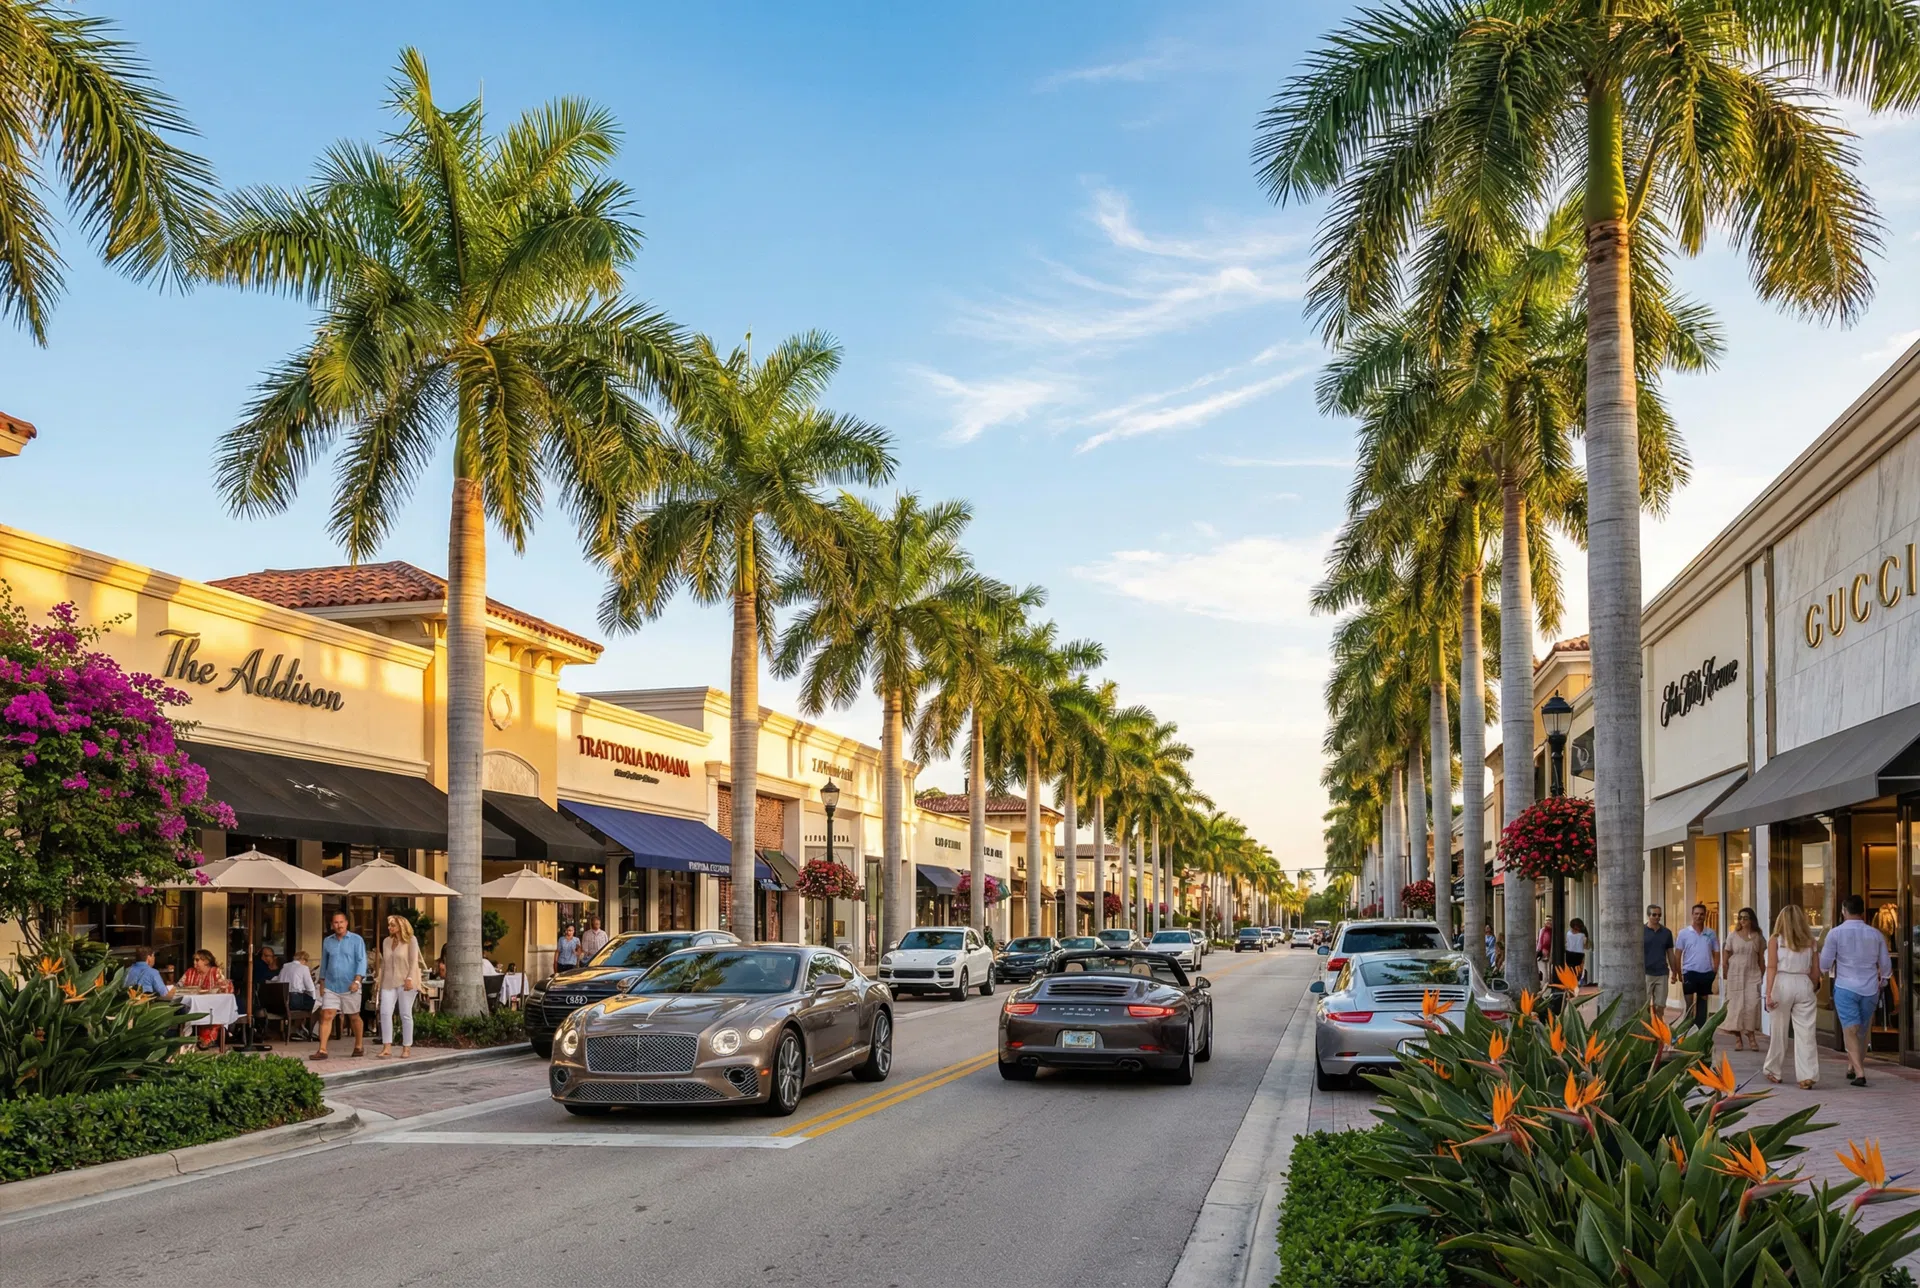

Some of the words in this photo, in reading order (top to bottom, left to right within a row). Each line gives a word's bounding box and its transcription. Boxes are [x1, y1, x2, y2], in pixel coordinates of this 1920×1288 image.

[1805, 543, 1917, 649] GUCCI
[157, 629, 218, 685] The
[216, 648, 344, 712] Addison
[576, 735, 644, 768] TRATTORIA
[645, 751, 691, 778] ROMANA
